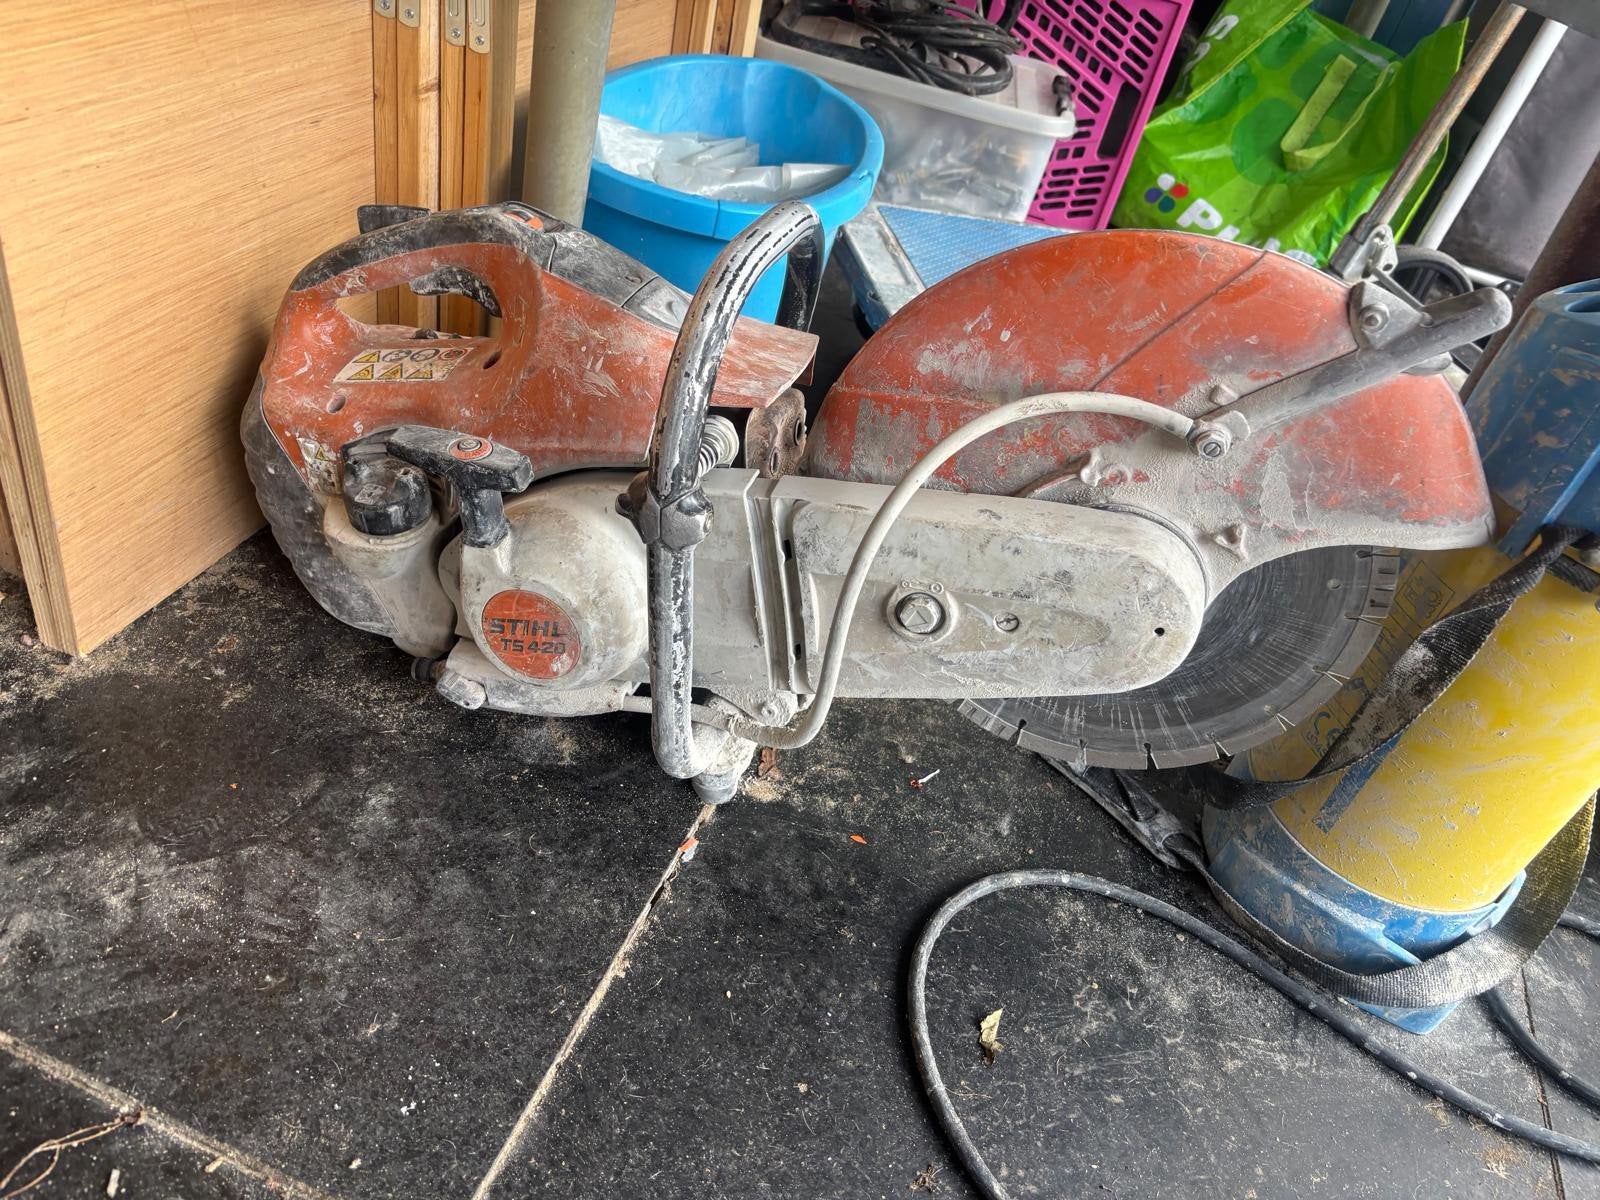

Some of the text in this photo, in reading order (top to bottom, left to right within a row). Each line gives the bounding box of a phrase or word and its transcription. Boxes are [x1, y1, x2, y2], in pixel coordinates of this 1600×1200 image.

[489, 617, 568, 638] STIHL
[500, 637, 566, 655] TS 420
